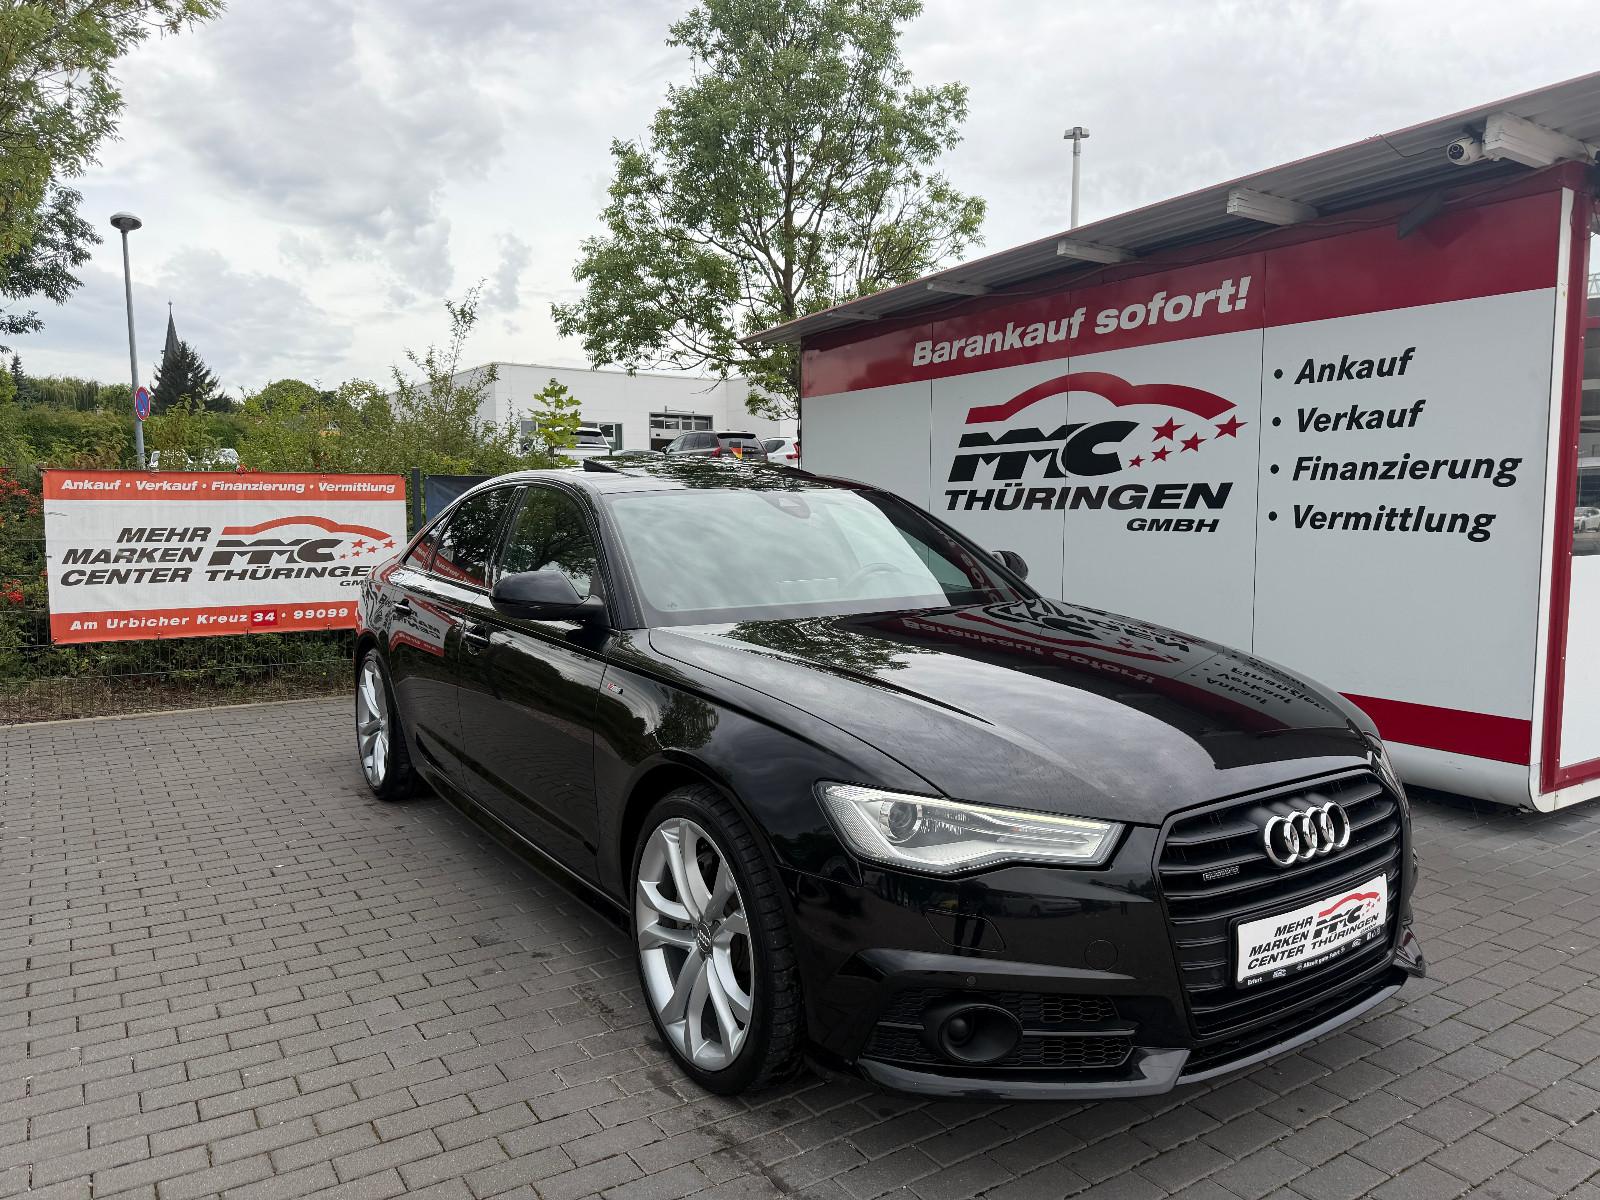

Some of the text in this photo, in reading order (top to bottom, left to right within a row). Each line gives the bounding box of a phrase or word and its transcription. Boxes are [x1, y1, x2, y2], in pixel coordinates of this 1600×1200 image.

[912, 275, 1252, 367] Barankauf sofort!
[1294, 346, 1416, 385] Ankauf
[1297, 399, 1426, 433] Verkauf
[947, 420, 1140, 482] MMC
[1292, 452, 1523, 488] Finanzierung
[61, 479, 396, 494] Ankauf Verkauf Finanzierung Vermittlung
[944, 481, 1234, 511] THÜRINGEN
[116, 527, 212, 544] MEHR
[1126, 518, 1220, 533] GMBH
[1293, 504, 1496, 543] Vermittlung
[62, 547, 204, 565] MARKEN
[60, 565, 372, 586] CENTER THÜRINGE
[70, 618, 98, 631] Am
[106, 614, 190, 629] Urbicher
[196, 613, 248, 625] Kreuz
[252, 612, 276, 623] 34
[293, 608, 349, 620] 99099
[1274, 916, 1313, 937] MEHR
[1247, 943, 1306, 970] CENTER
[1311, 913, 1379, 950] THÜRINGEN
[1249, 929, 1311, 958] MARKEN
